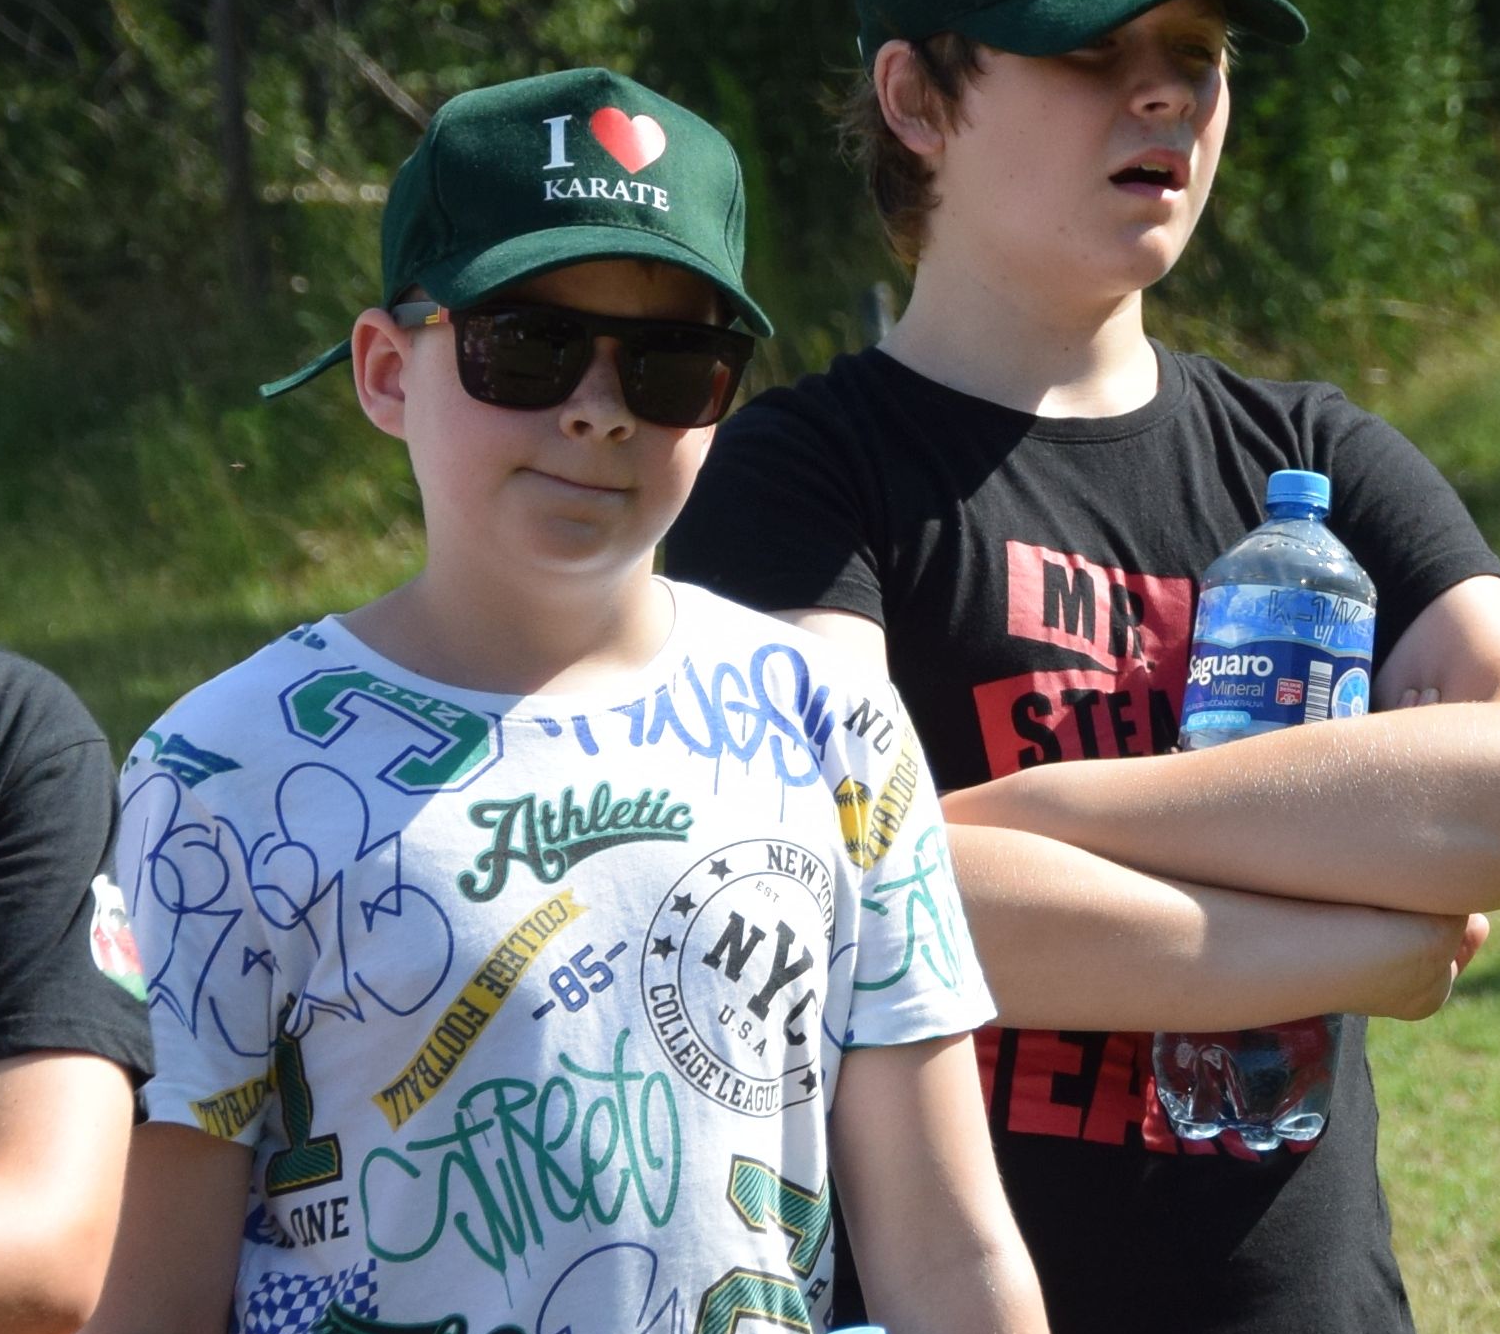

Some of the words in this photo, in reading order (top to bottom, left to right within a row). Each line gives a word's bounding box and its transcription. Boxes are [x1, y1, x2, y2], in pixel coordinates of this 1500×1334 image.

[542, 114, 575, 171] I
[543, 176, 671, 213] KARATE
[1186, 653, 1275, 687] Saguaro
[1211, 681, 1265, 698] Mineral
[455, 779, 695, 903] Athletic
[766, 843, 819, 886] NEW
[474, 898, 570, 1000] COLLEGE
[701, 910, 818, 1046] NYC
[381, 996, 490, 1127] FOOTBALL
[648, 983, 720, 1090] COLLEGE
